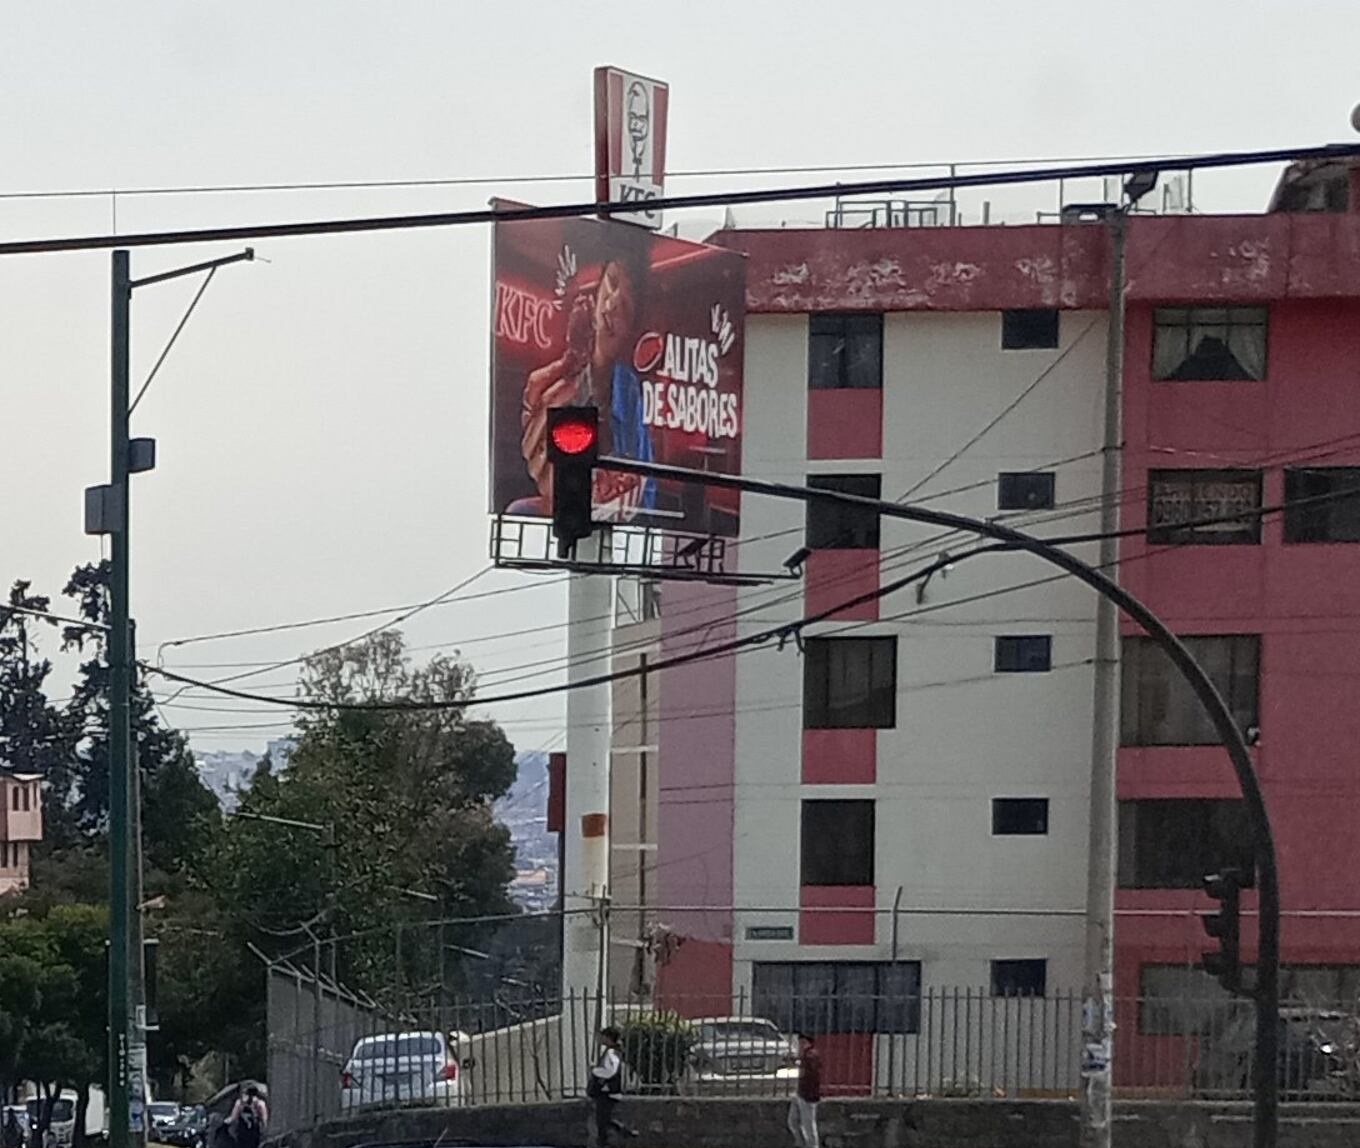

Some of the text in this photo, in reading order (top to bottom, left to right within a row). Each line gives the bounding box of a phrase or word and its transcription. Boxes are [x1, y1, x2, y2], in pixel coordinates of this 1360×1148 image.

[620, 183, 657, 219] KFC
[494, 284, 553, 349] KFC
[658, 333, 719, 389] ALITAS
[642, 380, 737, 438] DE SABORES
